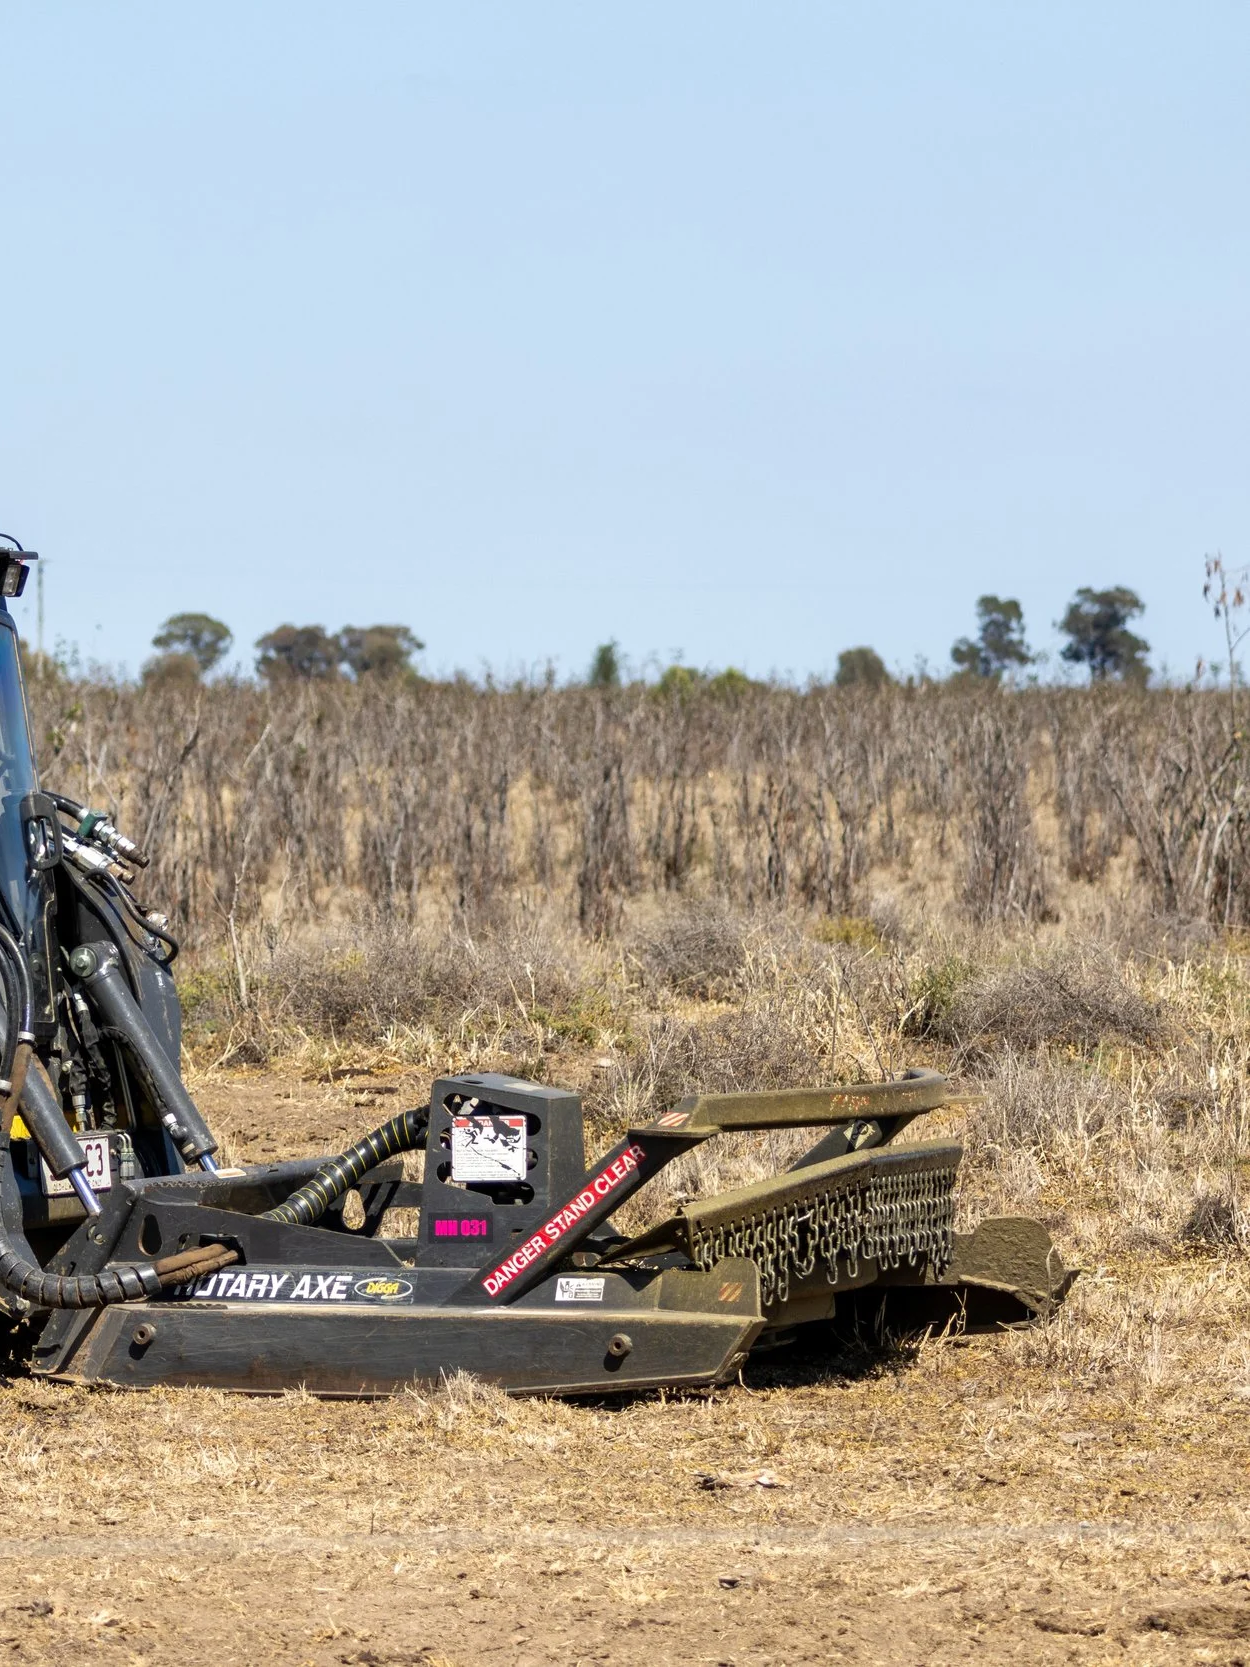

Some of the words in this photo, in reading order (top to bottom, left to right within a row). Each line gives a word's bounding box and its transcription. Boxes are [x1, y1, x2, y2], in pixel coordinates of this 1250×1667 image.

[460, 1219, 487, 1236] 031
[482, 1235, 547, 1296] DANGER
[544, 1191, 595, 1240] STAND
[594, 1145, 645, 1195] CLEAR
[290, 1274, 353, 1299] AXE
[365, 1281, 400, 1294] DIGGA
